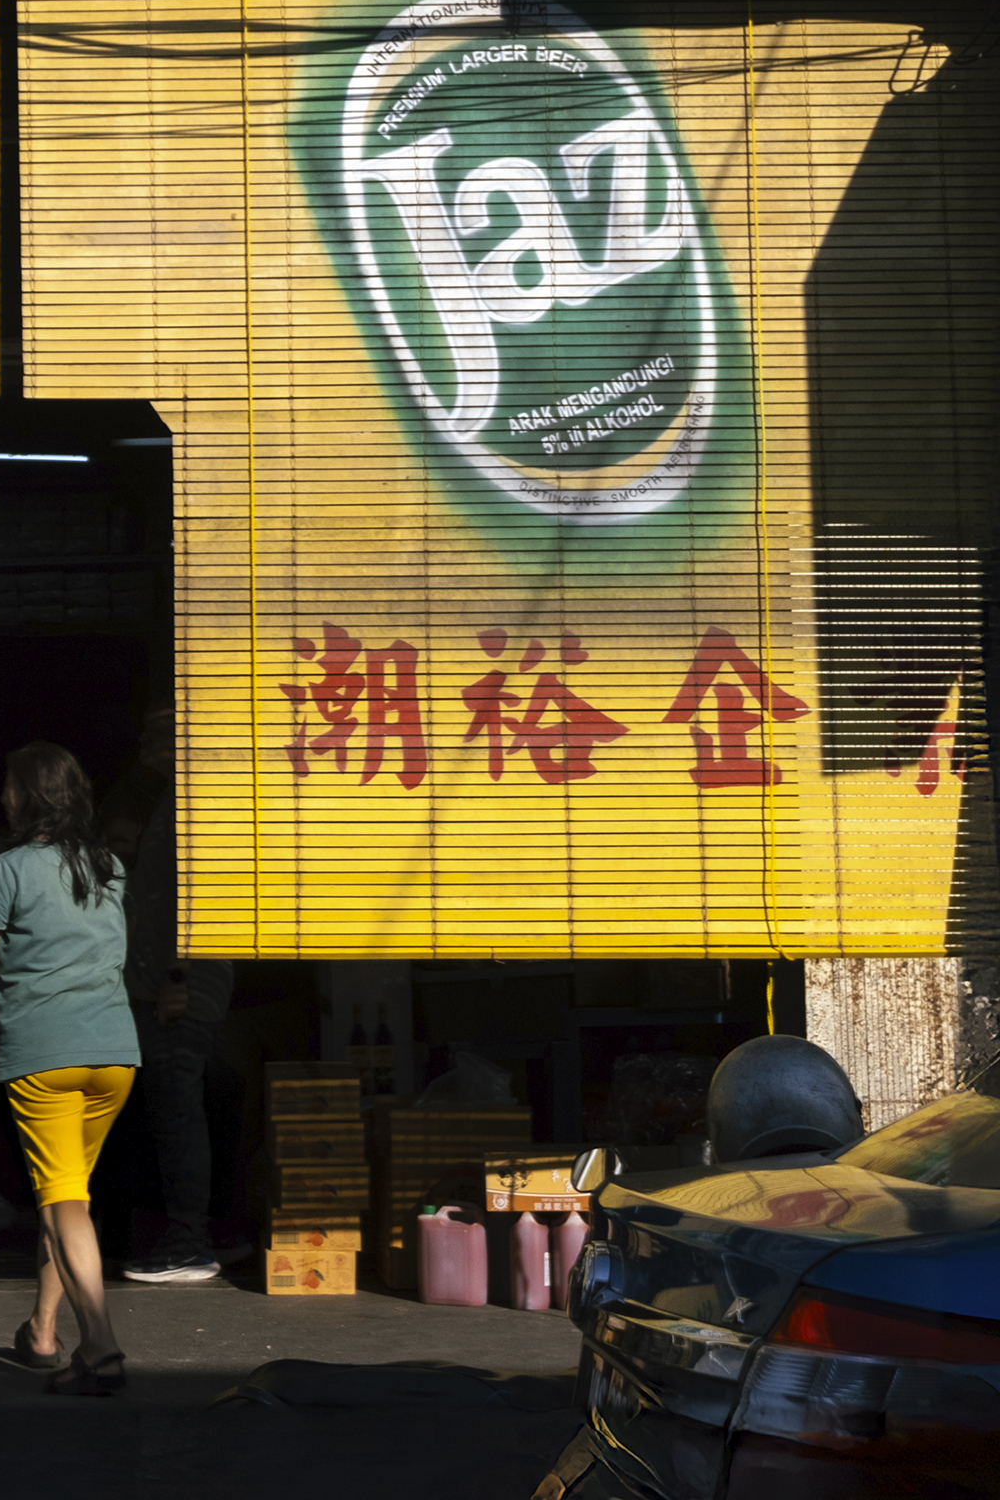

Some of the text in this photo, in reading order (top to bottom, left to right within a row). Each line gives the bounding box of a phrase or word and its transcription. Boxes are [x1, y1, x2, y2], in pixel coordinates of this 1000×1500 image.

[367, 0, 474, 76] INTERNATIONAL
[377, 43, 590, 141] PREMIUM LARGER BEER
[508, 406, 557, 437] ARAK
[540, 431, 569, 455] 5%
[586, 393, 666, 442] ALKOHOL
[610, 474, 663, 504] SMOOTH
